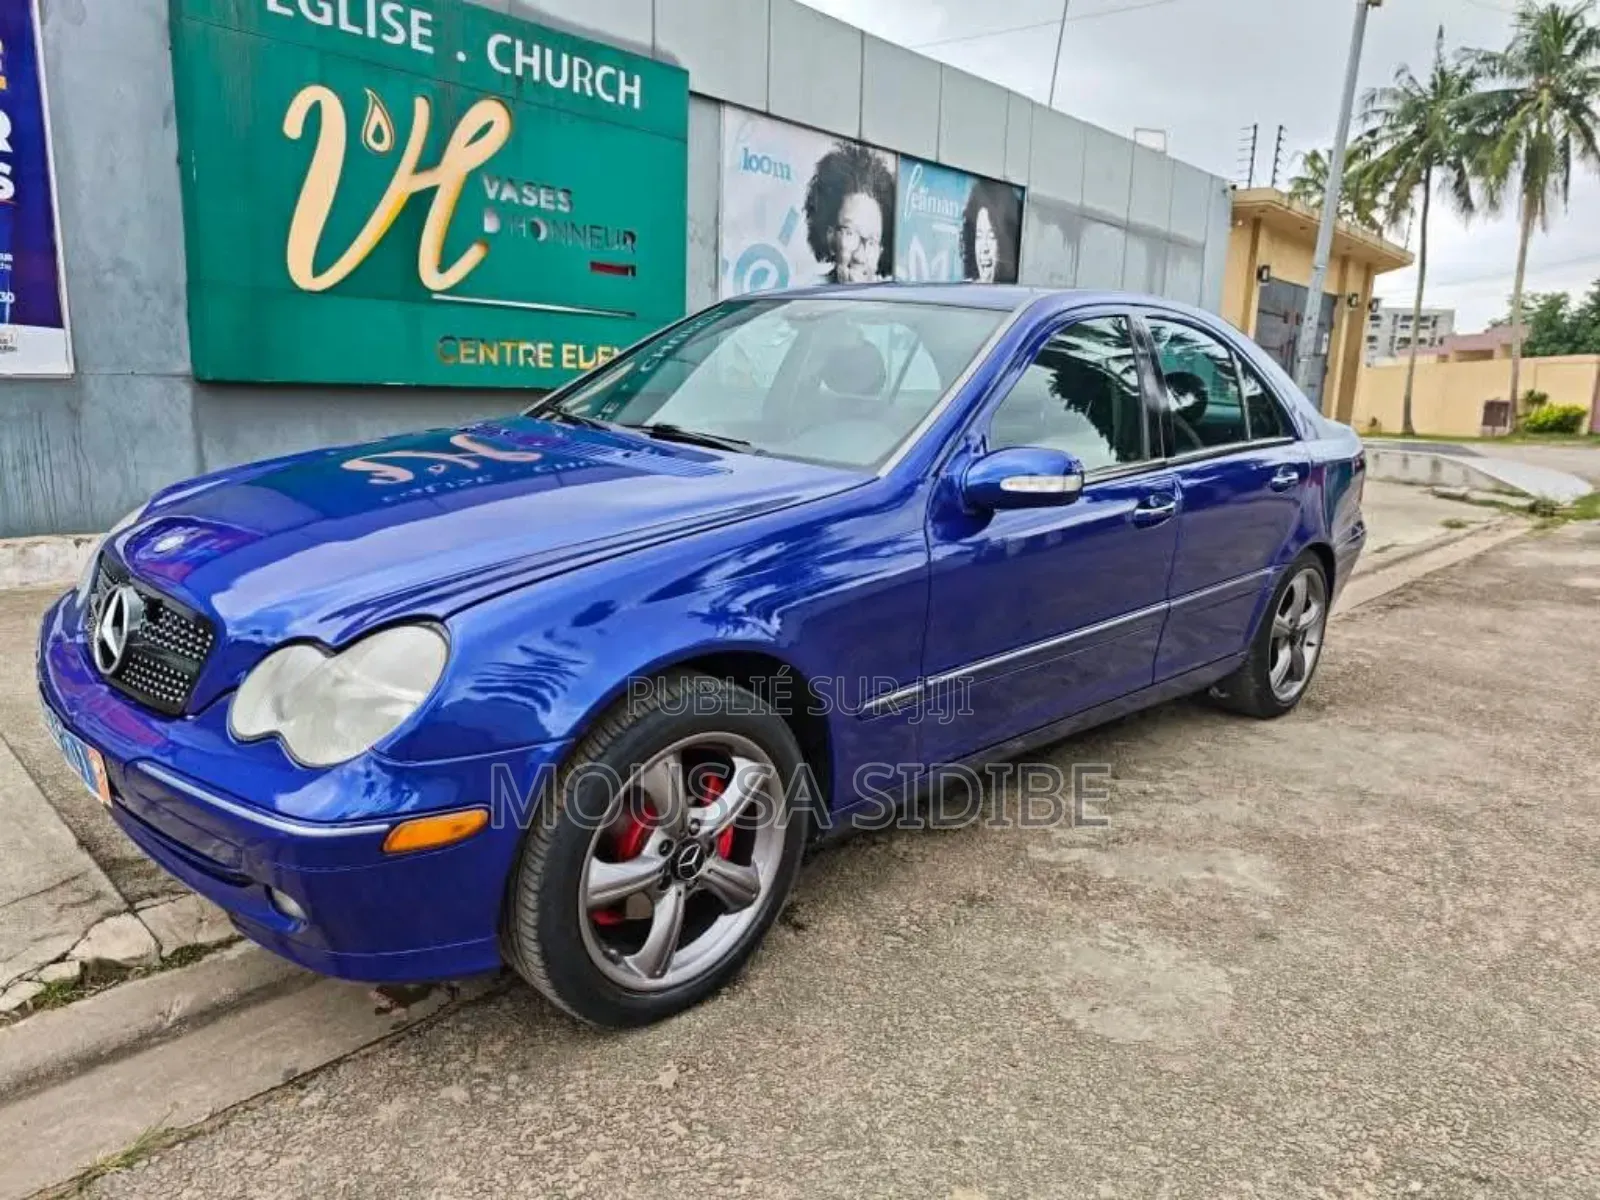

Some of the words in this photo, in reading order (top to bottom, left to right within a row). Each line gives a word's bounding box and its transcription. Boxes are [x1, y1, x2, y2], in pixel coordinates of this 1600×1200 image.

[487, 33, 641, 109] CHURCH
[482, 173, 573, 213] VASES
[483, 207, 637, 254] DHONNEUR
[437, 335, 555, 369] CENTRE
